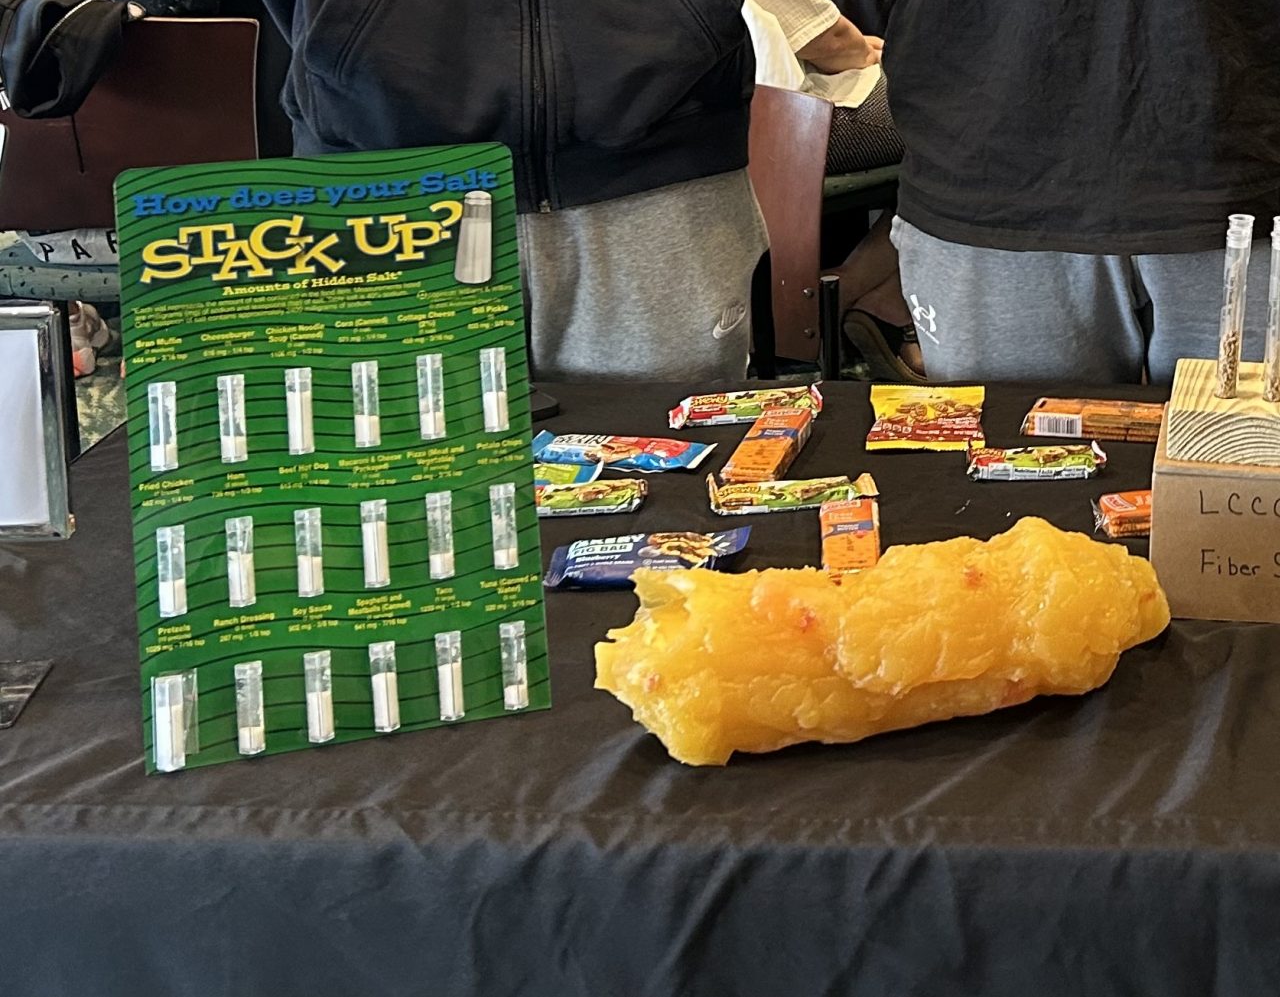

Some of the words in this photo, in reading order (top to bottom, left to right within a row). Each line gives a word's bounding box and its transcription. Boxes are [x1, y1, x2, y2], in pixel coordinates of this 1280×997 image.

[132, 191, 226, 218] How
[230, 185, 315, 211] does
[323, 178, 413, 208] your
[418, 170, 498, 194] Salt
[140, 216, 345, 283] STACK
[348, 200, 464, 263] UP?
[222, 281, 290, 296] Amounts
[292, 279, 309, 289] of
[311, 272, 364, 288] Hidden
[575, 554, 621, 563] Blueberry
[599, 544, 628, 554] BAR
[1200, 549, 1260, 575] Fiber
